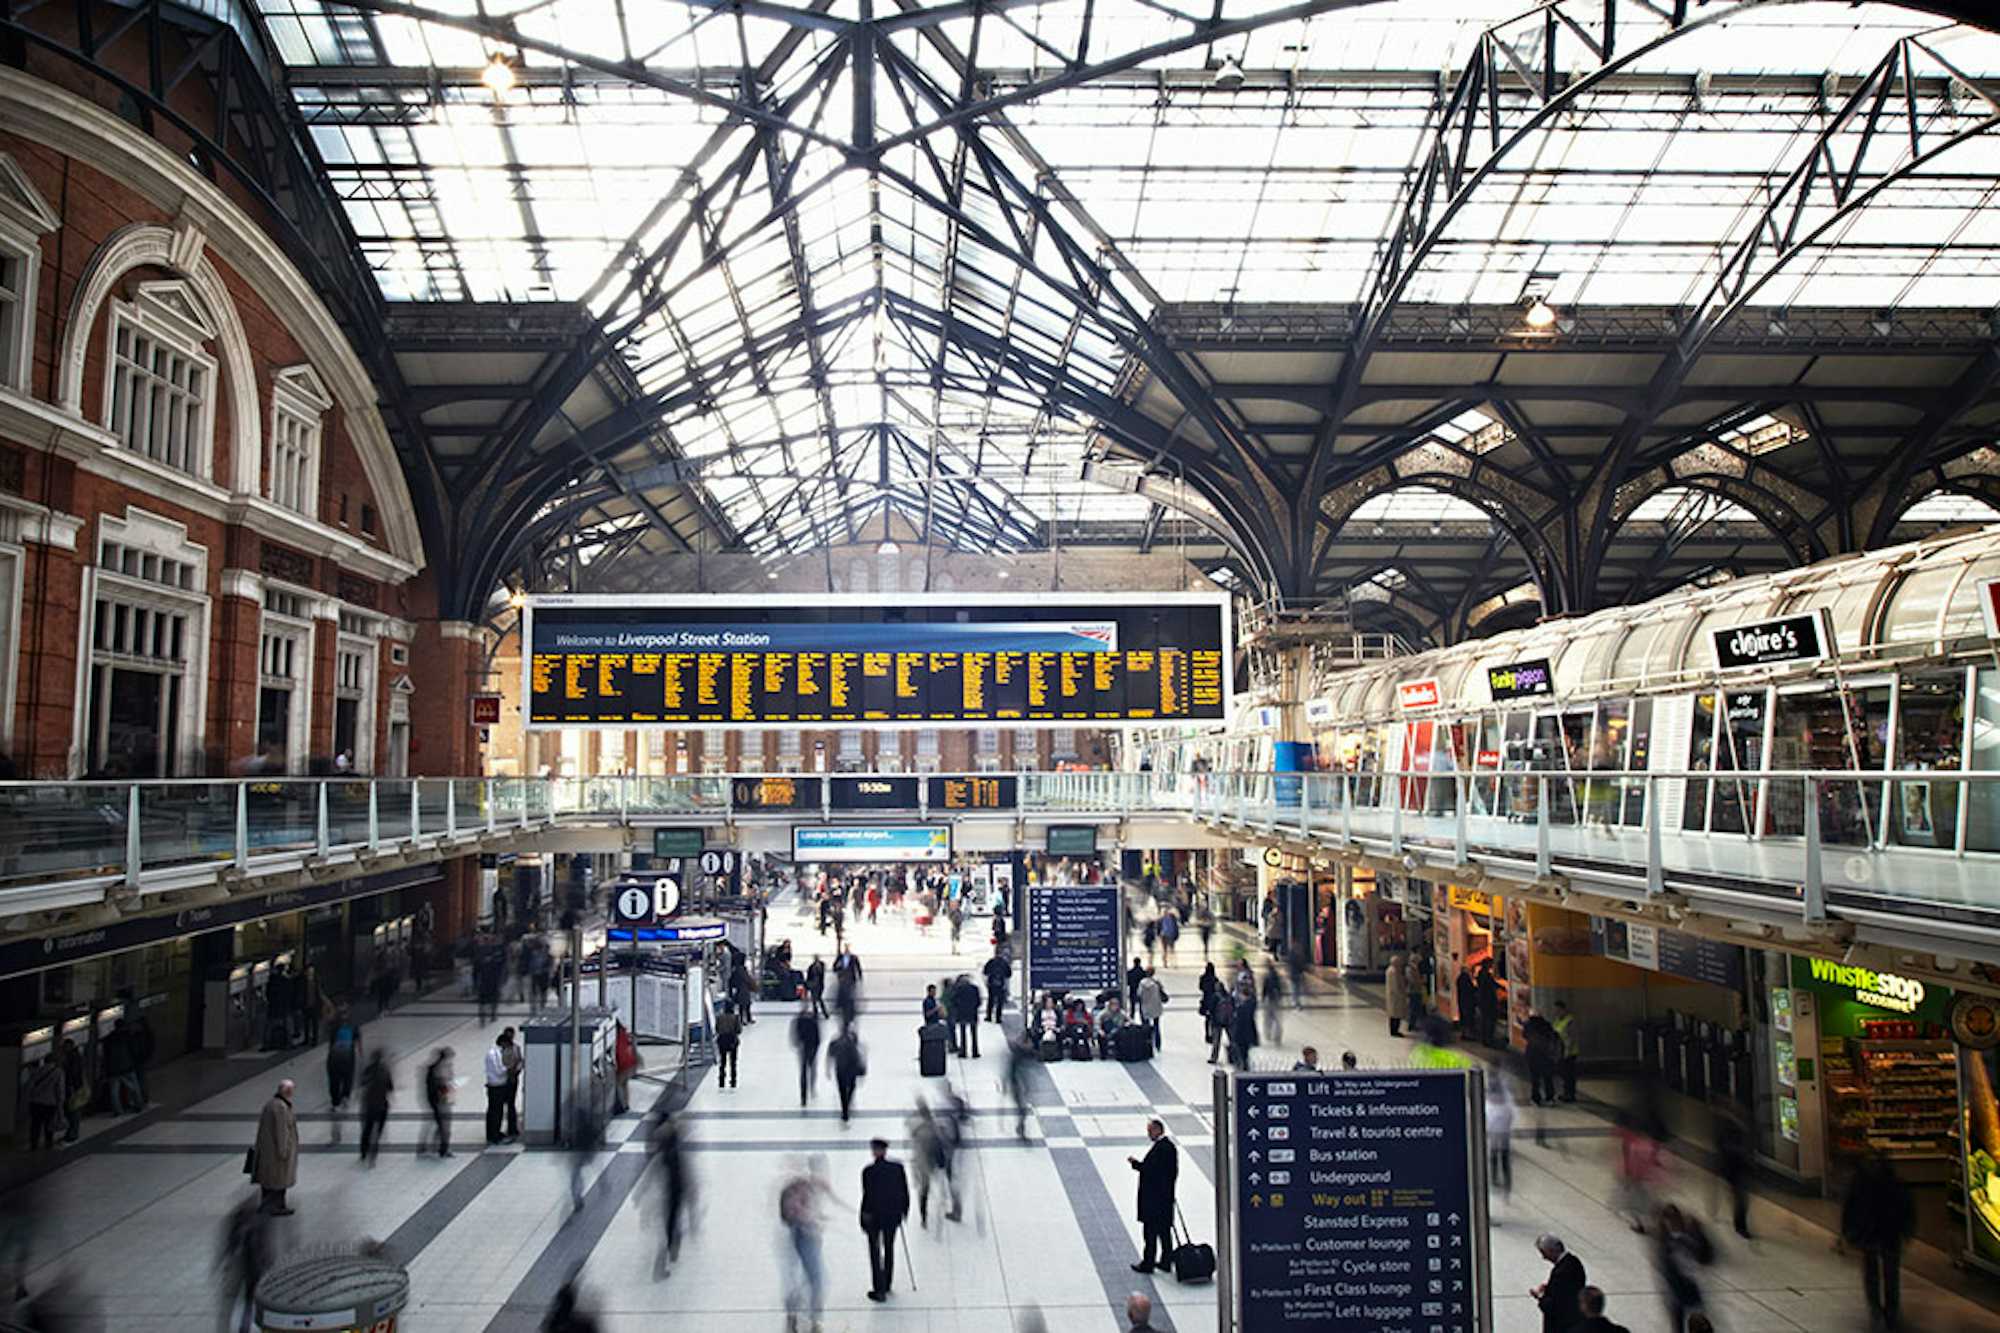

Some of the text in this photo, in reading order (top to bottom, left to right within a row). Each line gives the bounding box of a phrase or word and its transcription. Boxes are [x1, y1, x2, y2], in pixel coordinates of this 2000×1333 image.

[557, 632, 770, 649] Welcome to Liverpool Street Station
[1730, 625, 1799, 657] claire's
[1307, 1082, 1330, 1095] Lift
[1310, 1104, 1353, 1117] Tickets
[1356, 1103, 1366, 1117] &
[1310, 1125, 1443, 1139] Travel & tourist centre
[1310, 1148, 1378, 1162] Bus station
[1310, 1170, 1391, 1185] Underground
[1312, 1193, 1366, 1208] Way out
[1304, 1215, 1409, 1230] Stansted Express
[1306, 1237, 1366, 1251] Customer
[1368, 1237, 1411, 1252] lounge
[1343, 1260, 1377, 1276] Cycle
[1379, 1261, 1411, 1273] store
[1304, 1283, 1333, 1296] First
[1334, 1283, 1367, 1296] Class
[1369, 1283, 1412, 1298] lounge
[1335, 1305, 1361, 1318] Left
[1363, 1304, 1413, 1320] luggage
